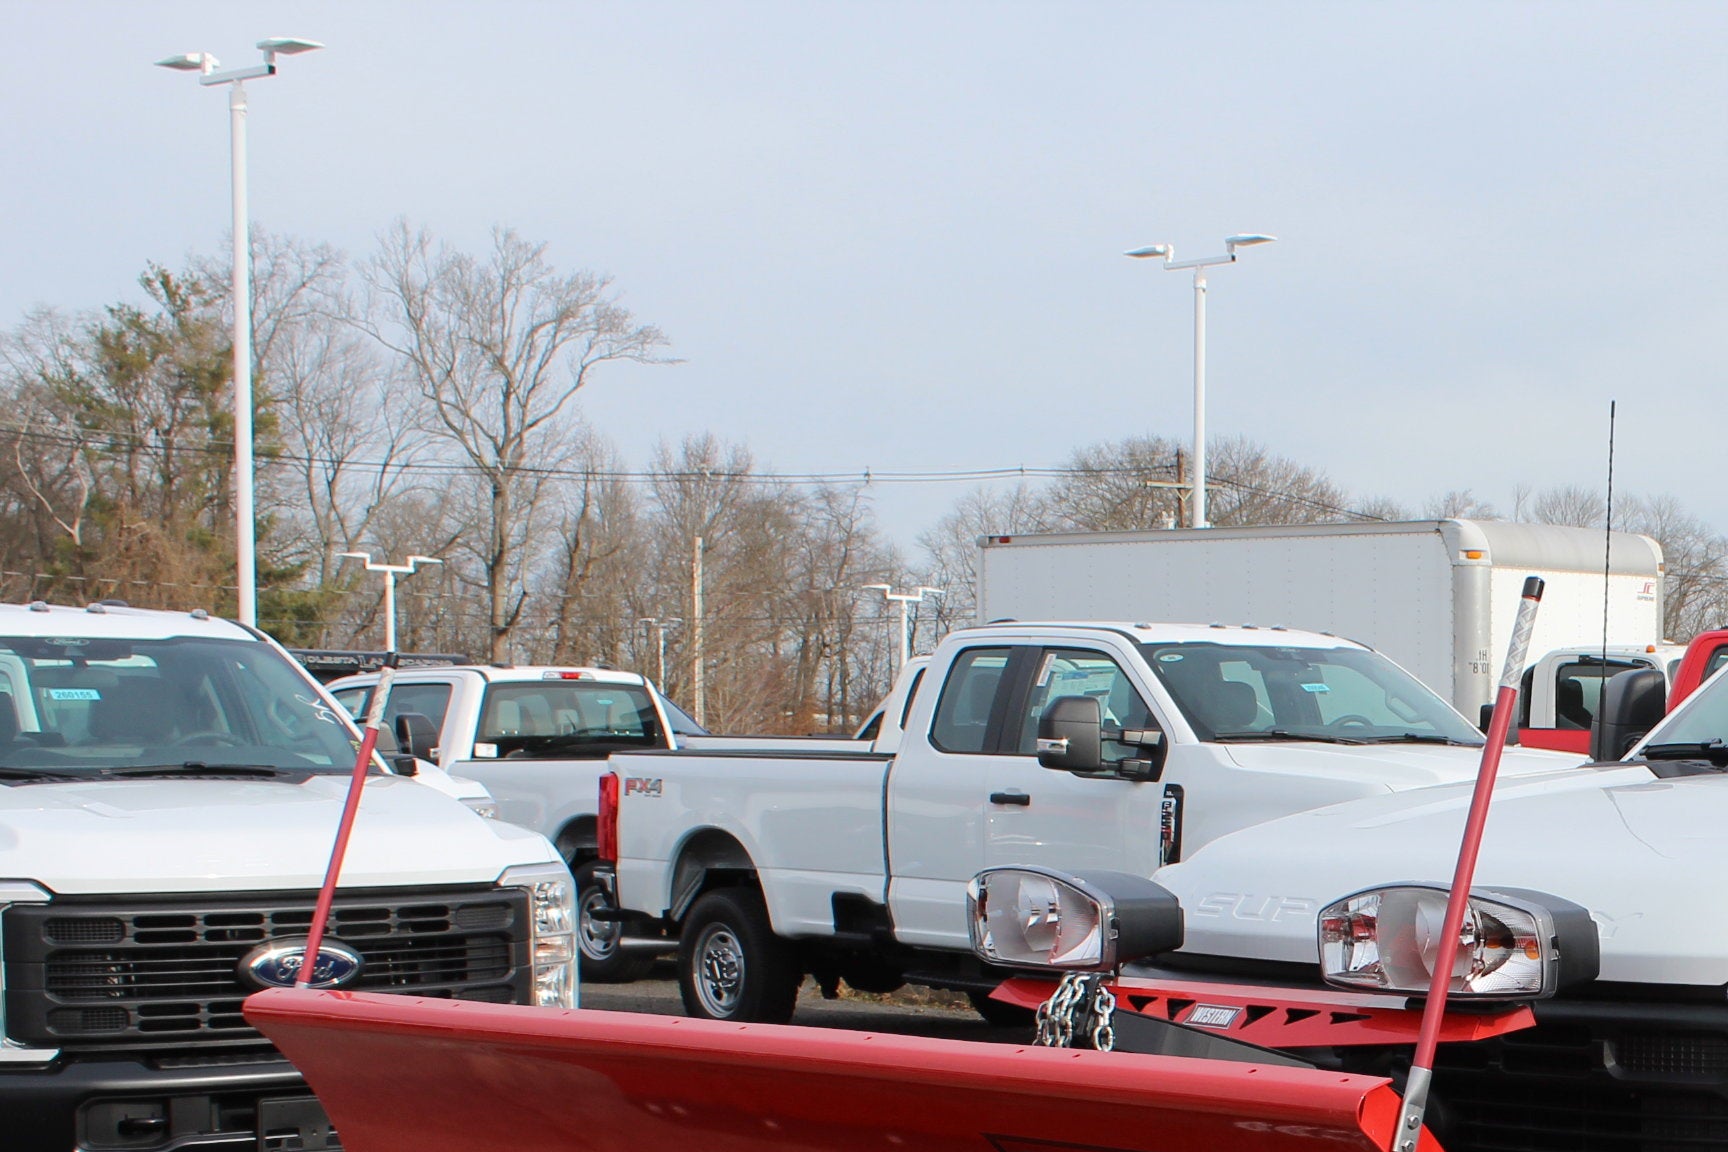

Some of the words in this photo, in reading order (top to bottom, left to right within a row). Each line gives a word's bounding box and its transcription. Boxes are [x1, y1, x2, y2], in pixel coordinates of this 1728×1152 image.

[624, 777, 662, 796] FX4
[1194, 892, 1318, 922] SUP
[1190, 1006, 1237, 1026] WESTERN
